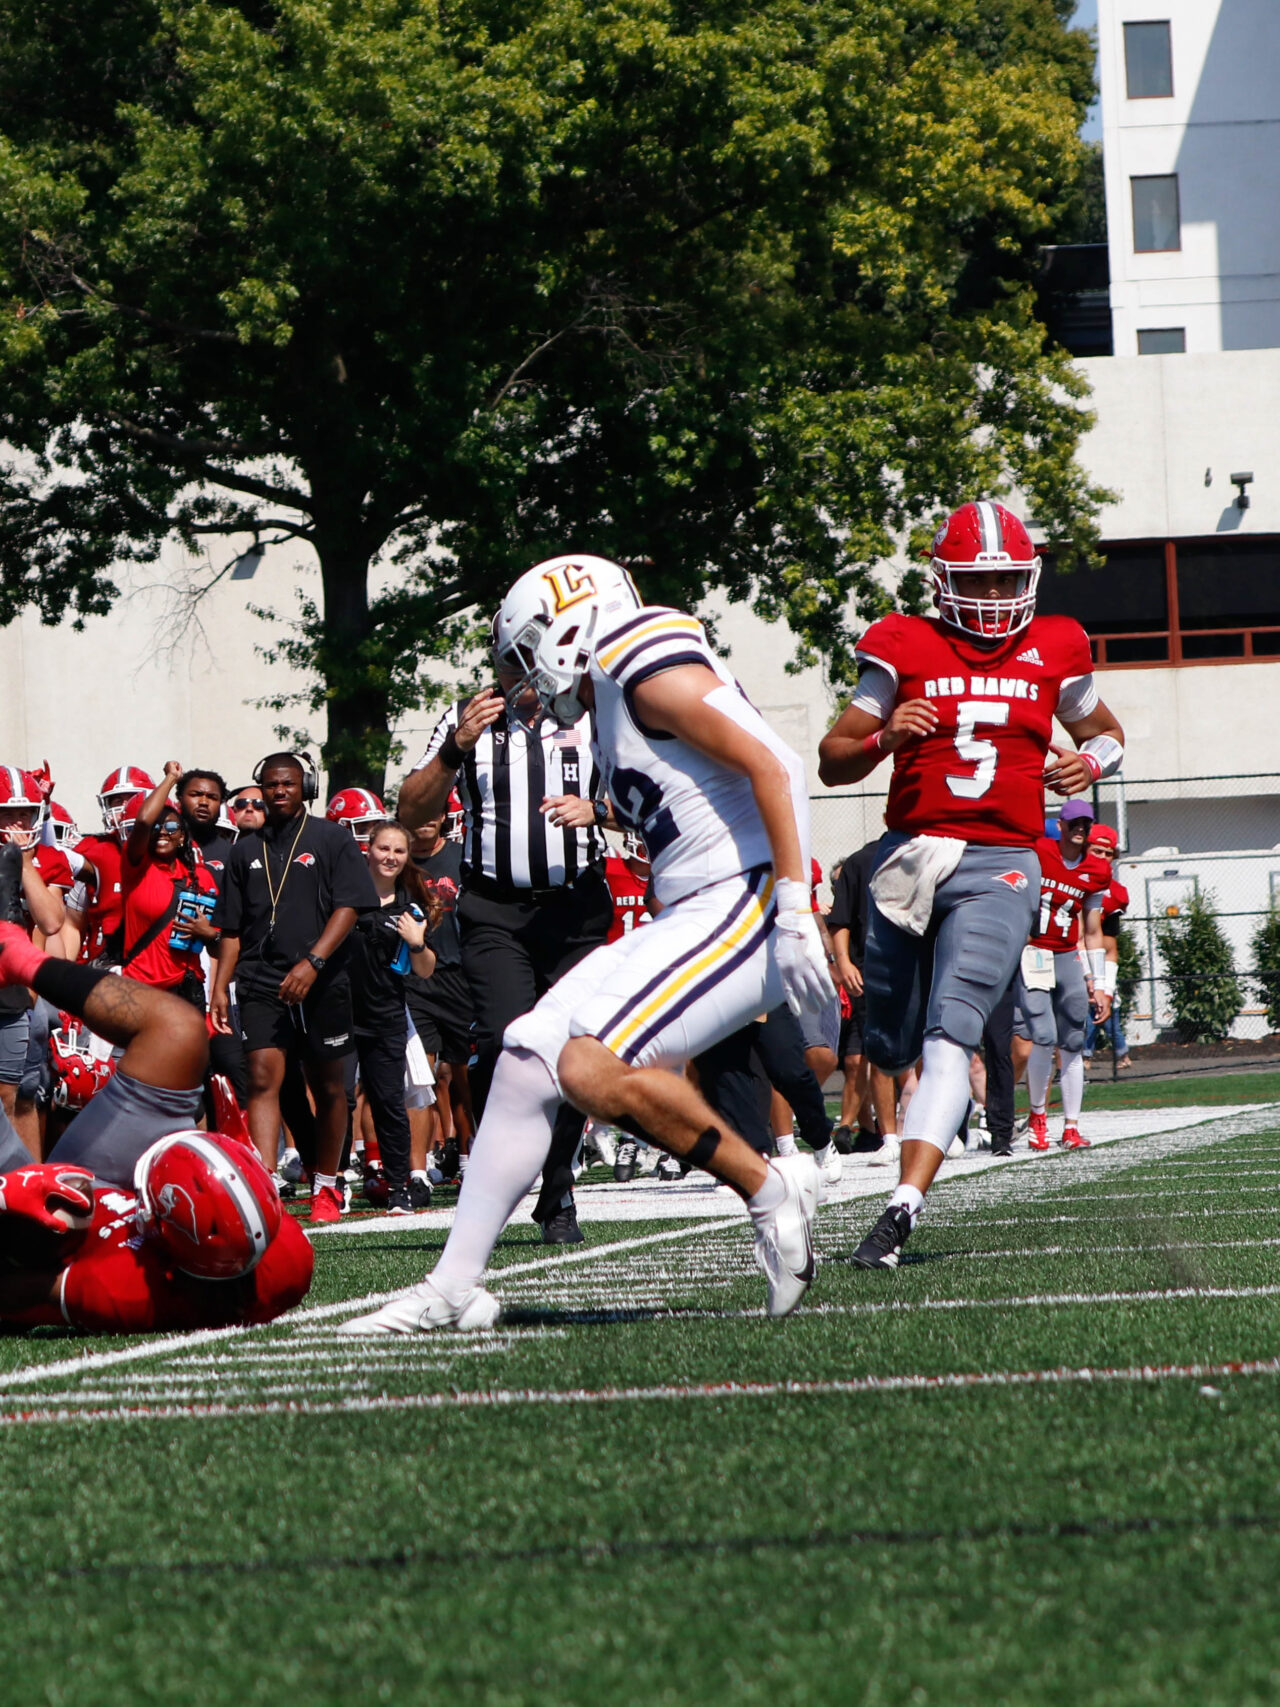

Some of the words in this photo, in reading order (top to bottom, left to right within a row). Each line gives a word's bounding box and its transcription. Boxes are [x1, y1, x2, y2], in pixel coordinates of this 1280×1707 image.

[1016, 655, 1044, 667] adidas
[924, 676, 966, 698] RED
[970, 676, 1039, 701] HAWKS
[945, 700, 1010, 800] 5
[563, 762, 579, 782] H
[1039, 877, 1057, 889] RED
[1057, 882, 1086, 899] HAWKS
[616, 896, 635, 906] RED
[1040, 891, 1075, 938] 14
